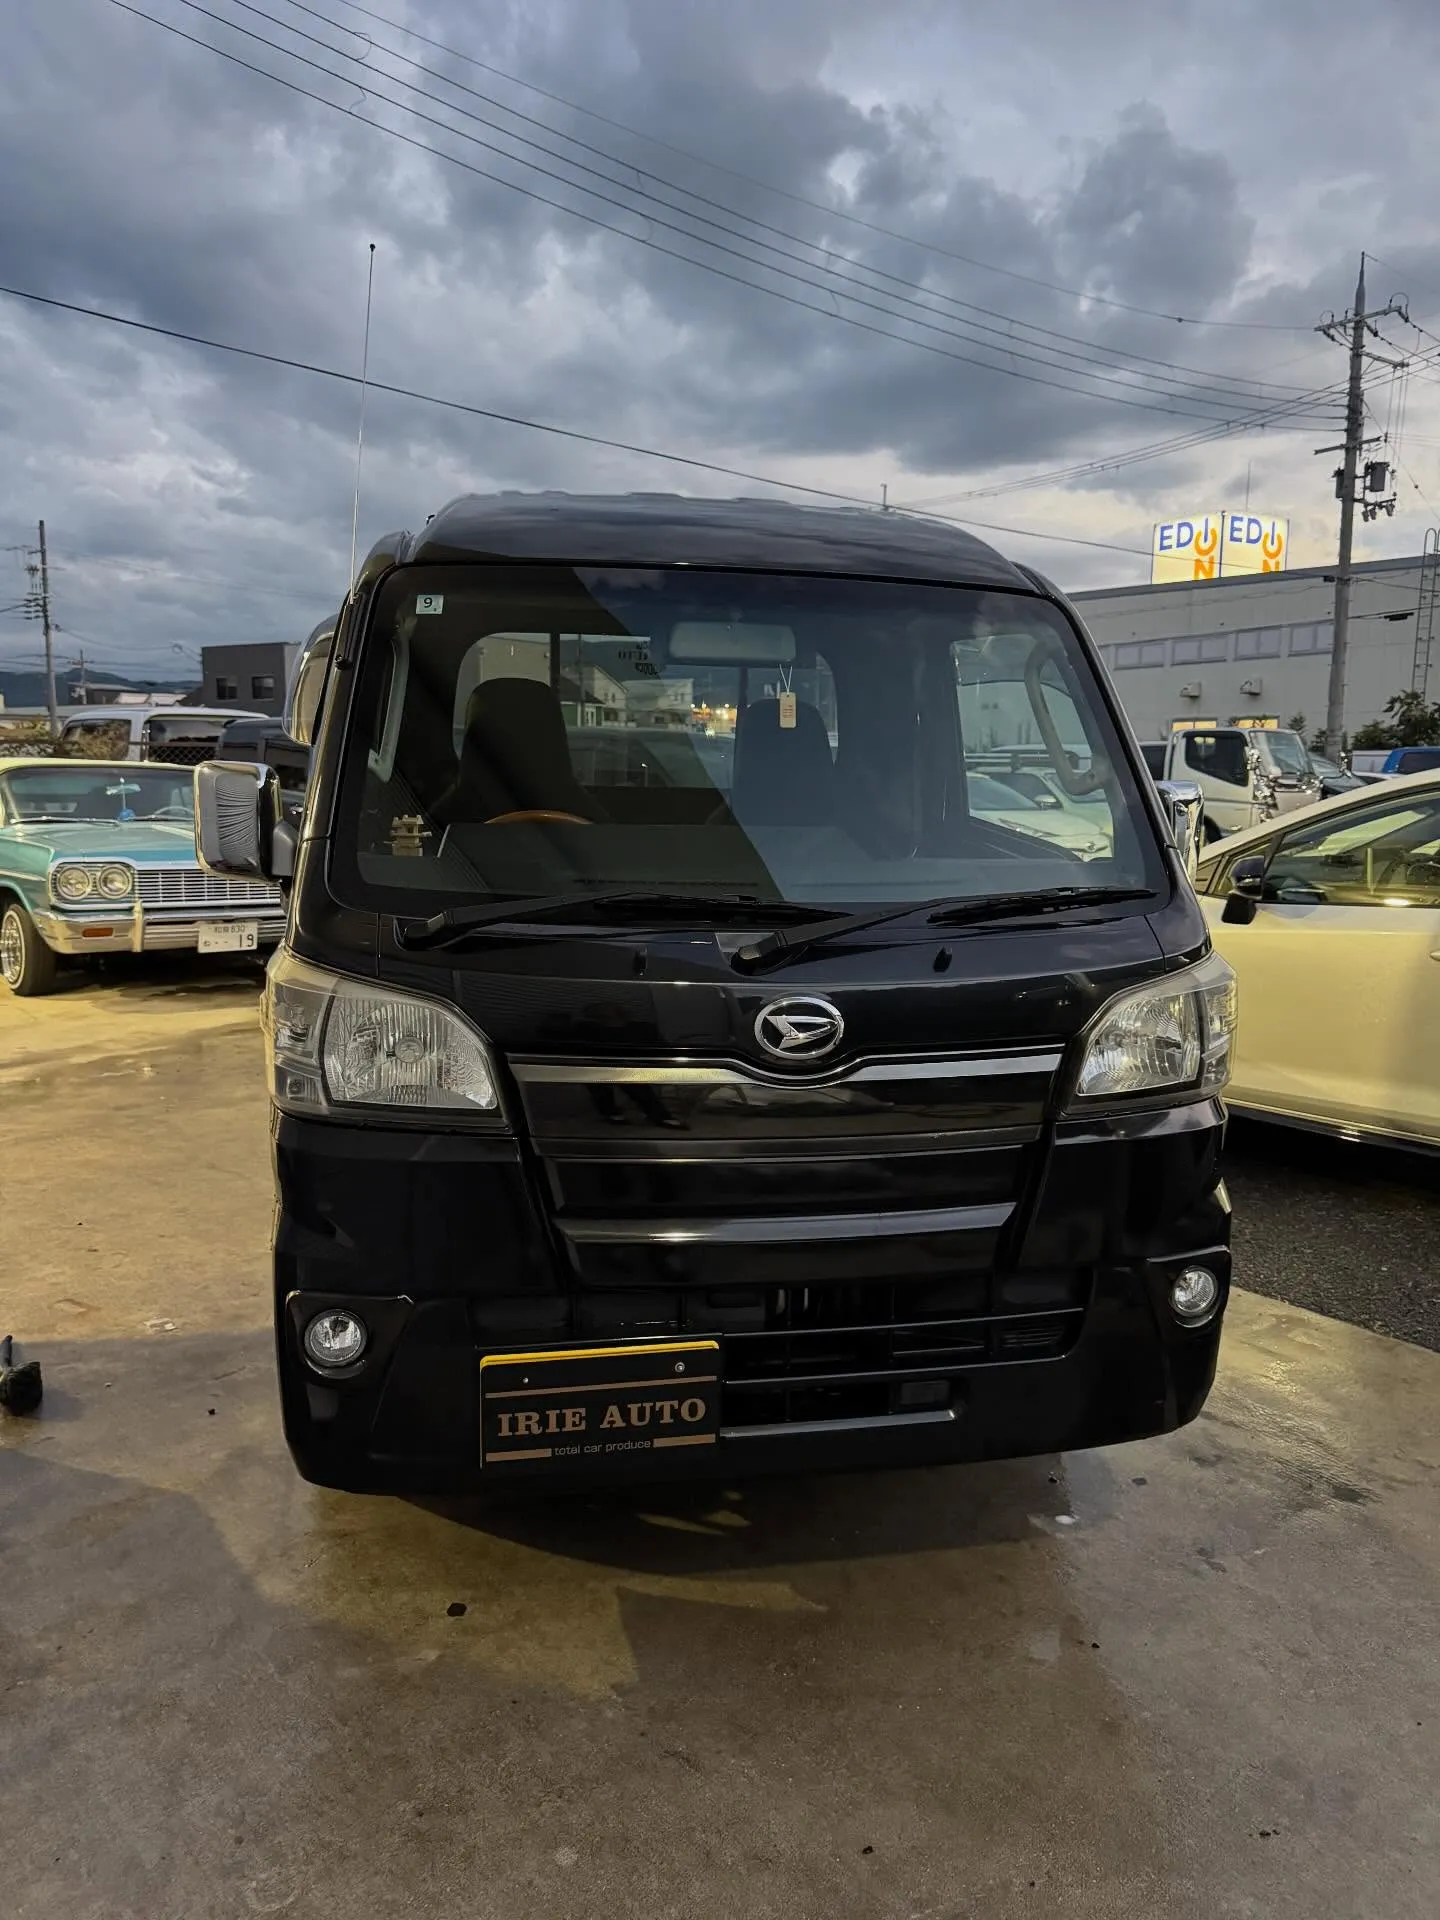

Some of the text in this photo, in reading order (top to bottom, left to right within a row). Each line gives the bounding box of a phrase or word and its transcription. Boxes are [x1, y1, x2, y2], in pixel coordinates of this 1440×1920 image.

[423, 597, 433, 608] 9
[498, 1398, 706, 1437] IRIE AUTO
[555, 1439, 651, 1456] total car produce
